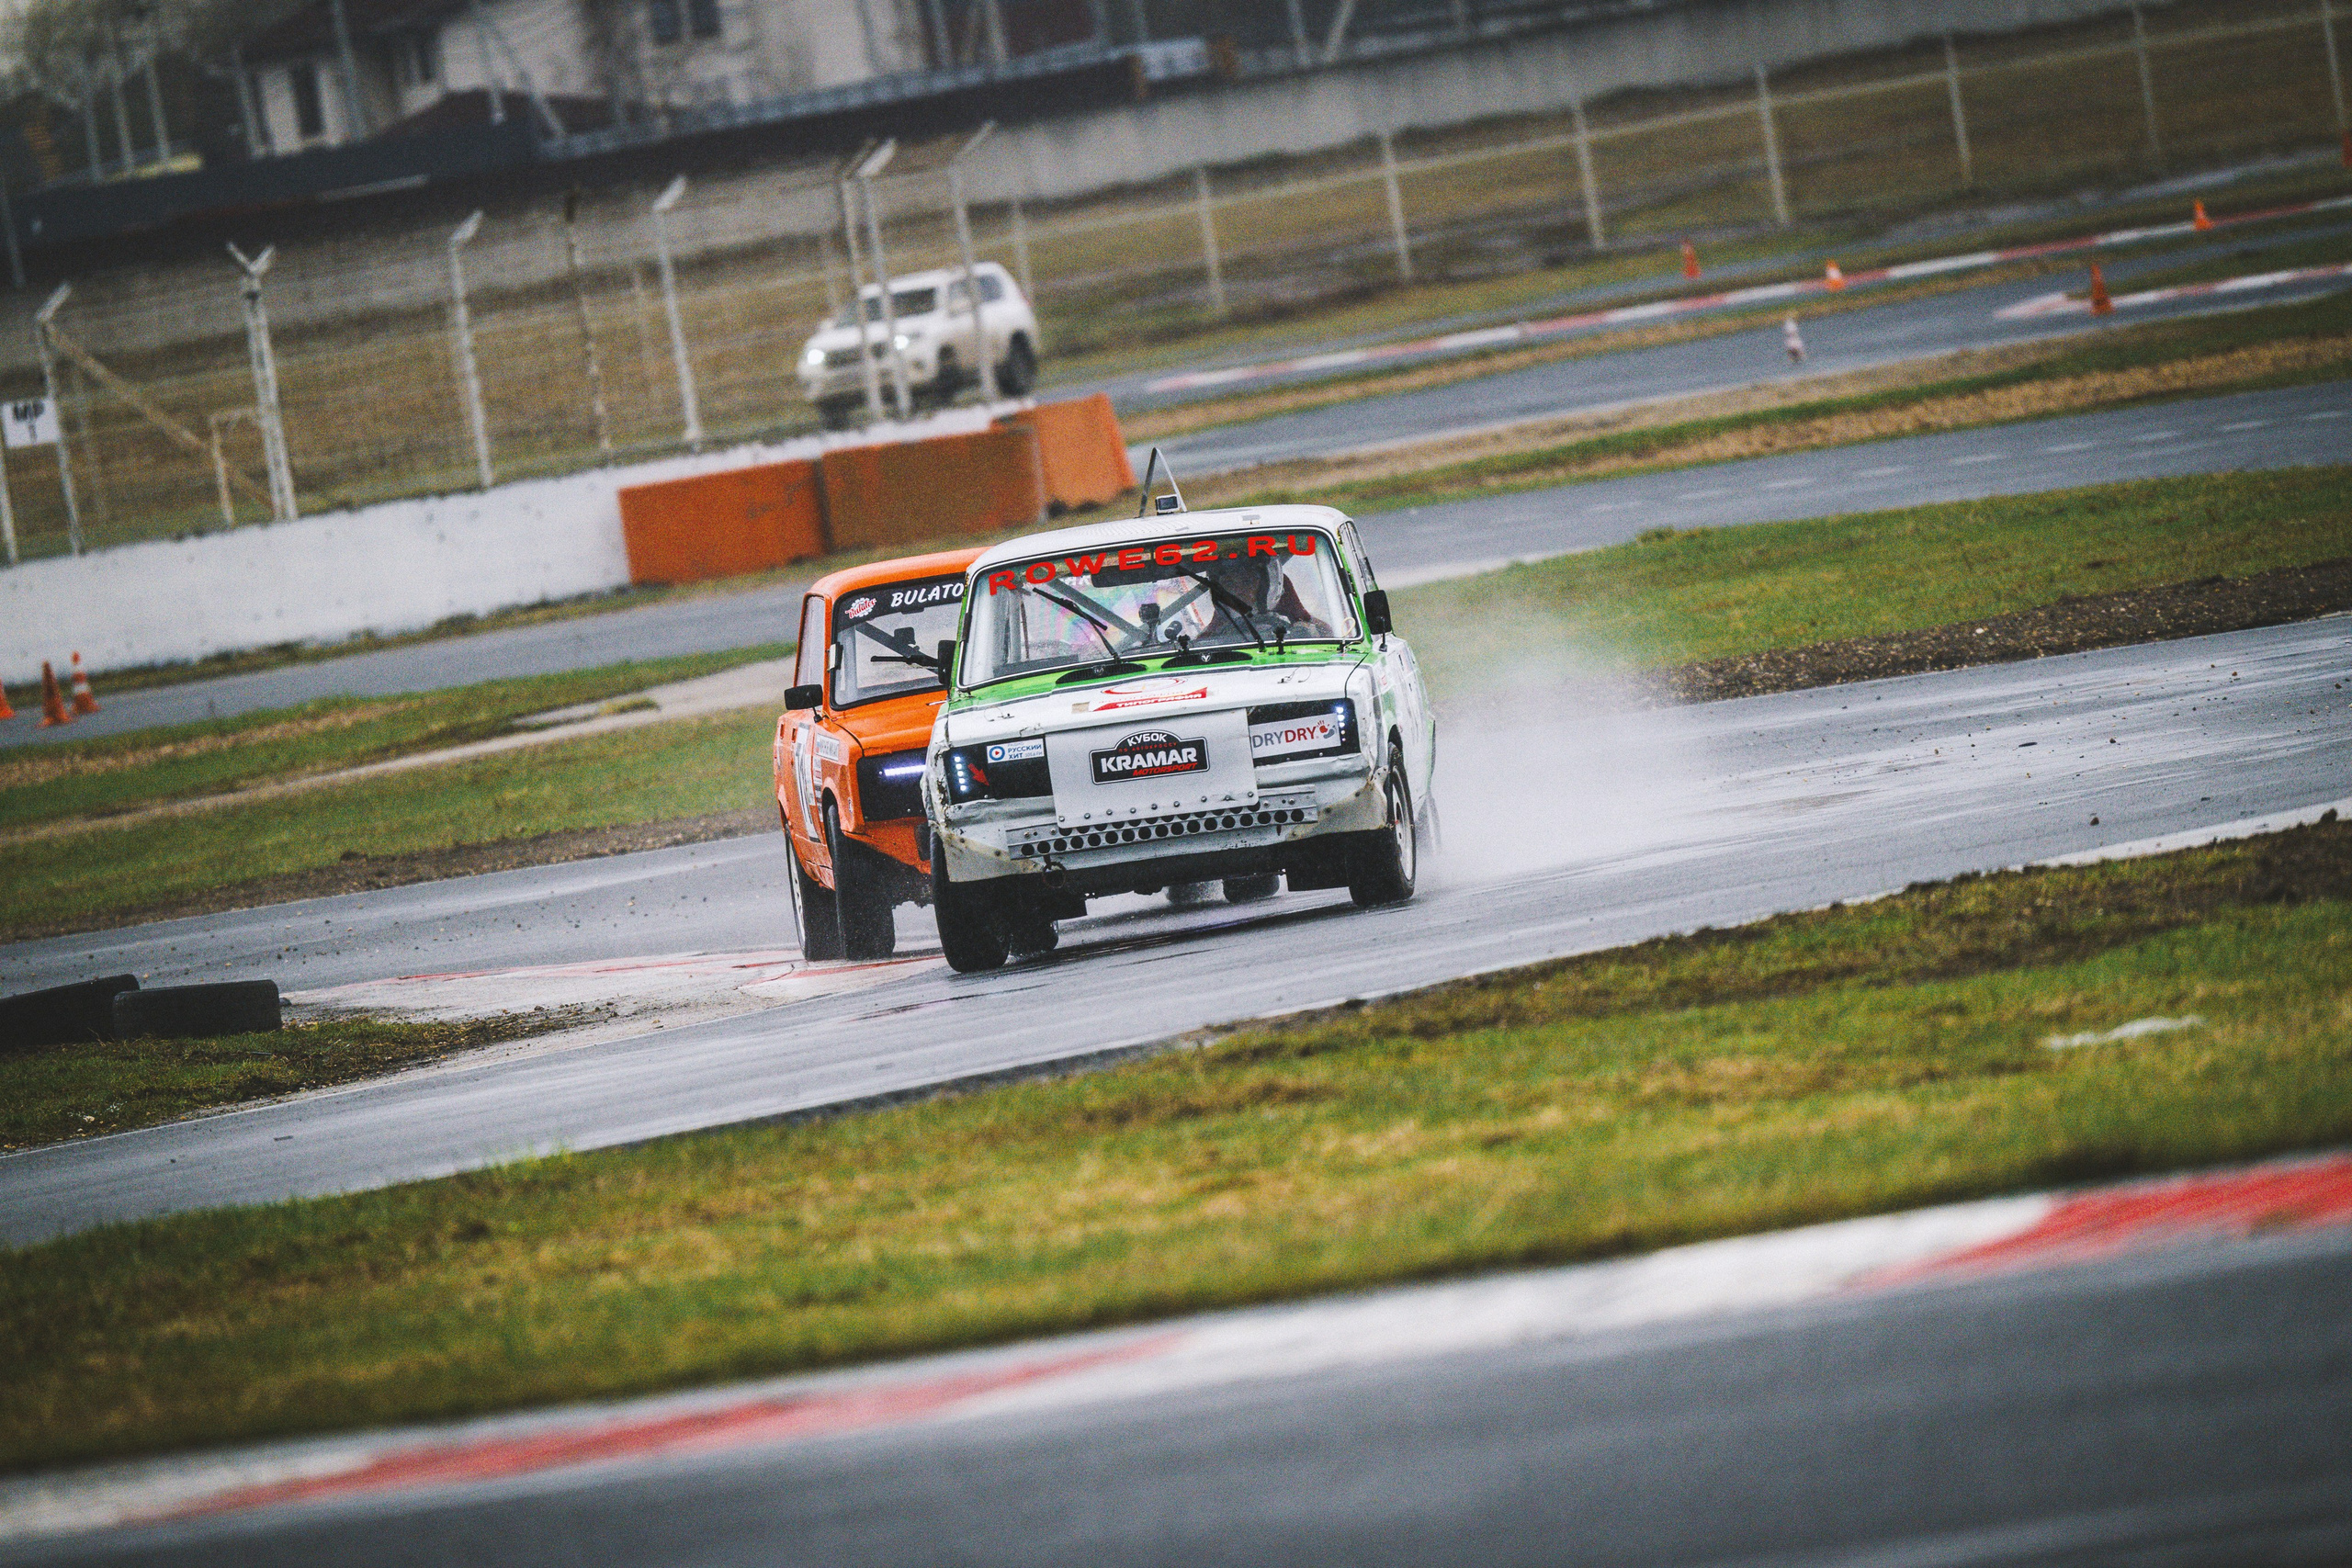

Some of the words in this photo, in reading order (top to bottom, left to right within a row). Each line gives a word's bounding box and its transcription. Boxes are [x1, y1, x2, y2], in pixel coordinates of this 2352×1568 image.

[989, 535, 1317, 596] ROWE62.RU
[890, 582, 964, 607] BULATO
[1115, 693, 1203, 708] ТИПОГРАФИЯ
[1127, 732, 1167, 747] КУБОК
[1007, 743, 1042, 754] РУССКИЙ
[1101, 747, 1198, 773] KRAMAR
[1132, 761, 1198, 776] MOTORSPORT
